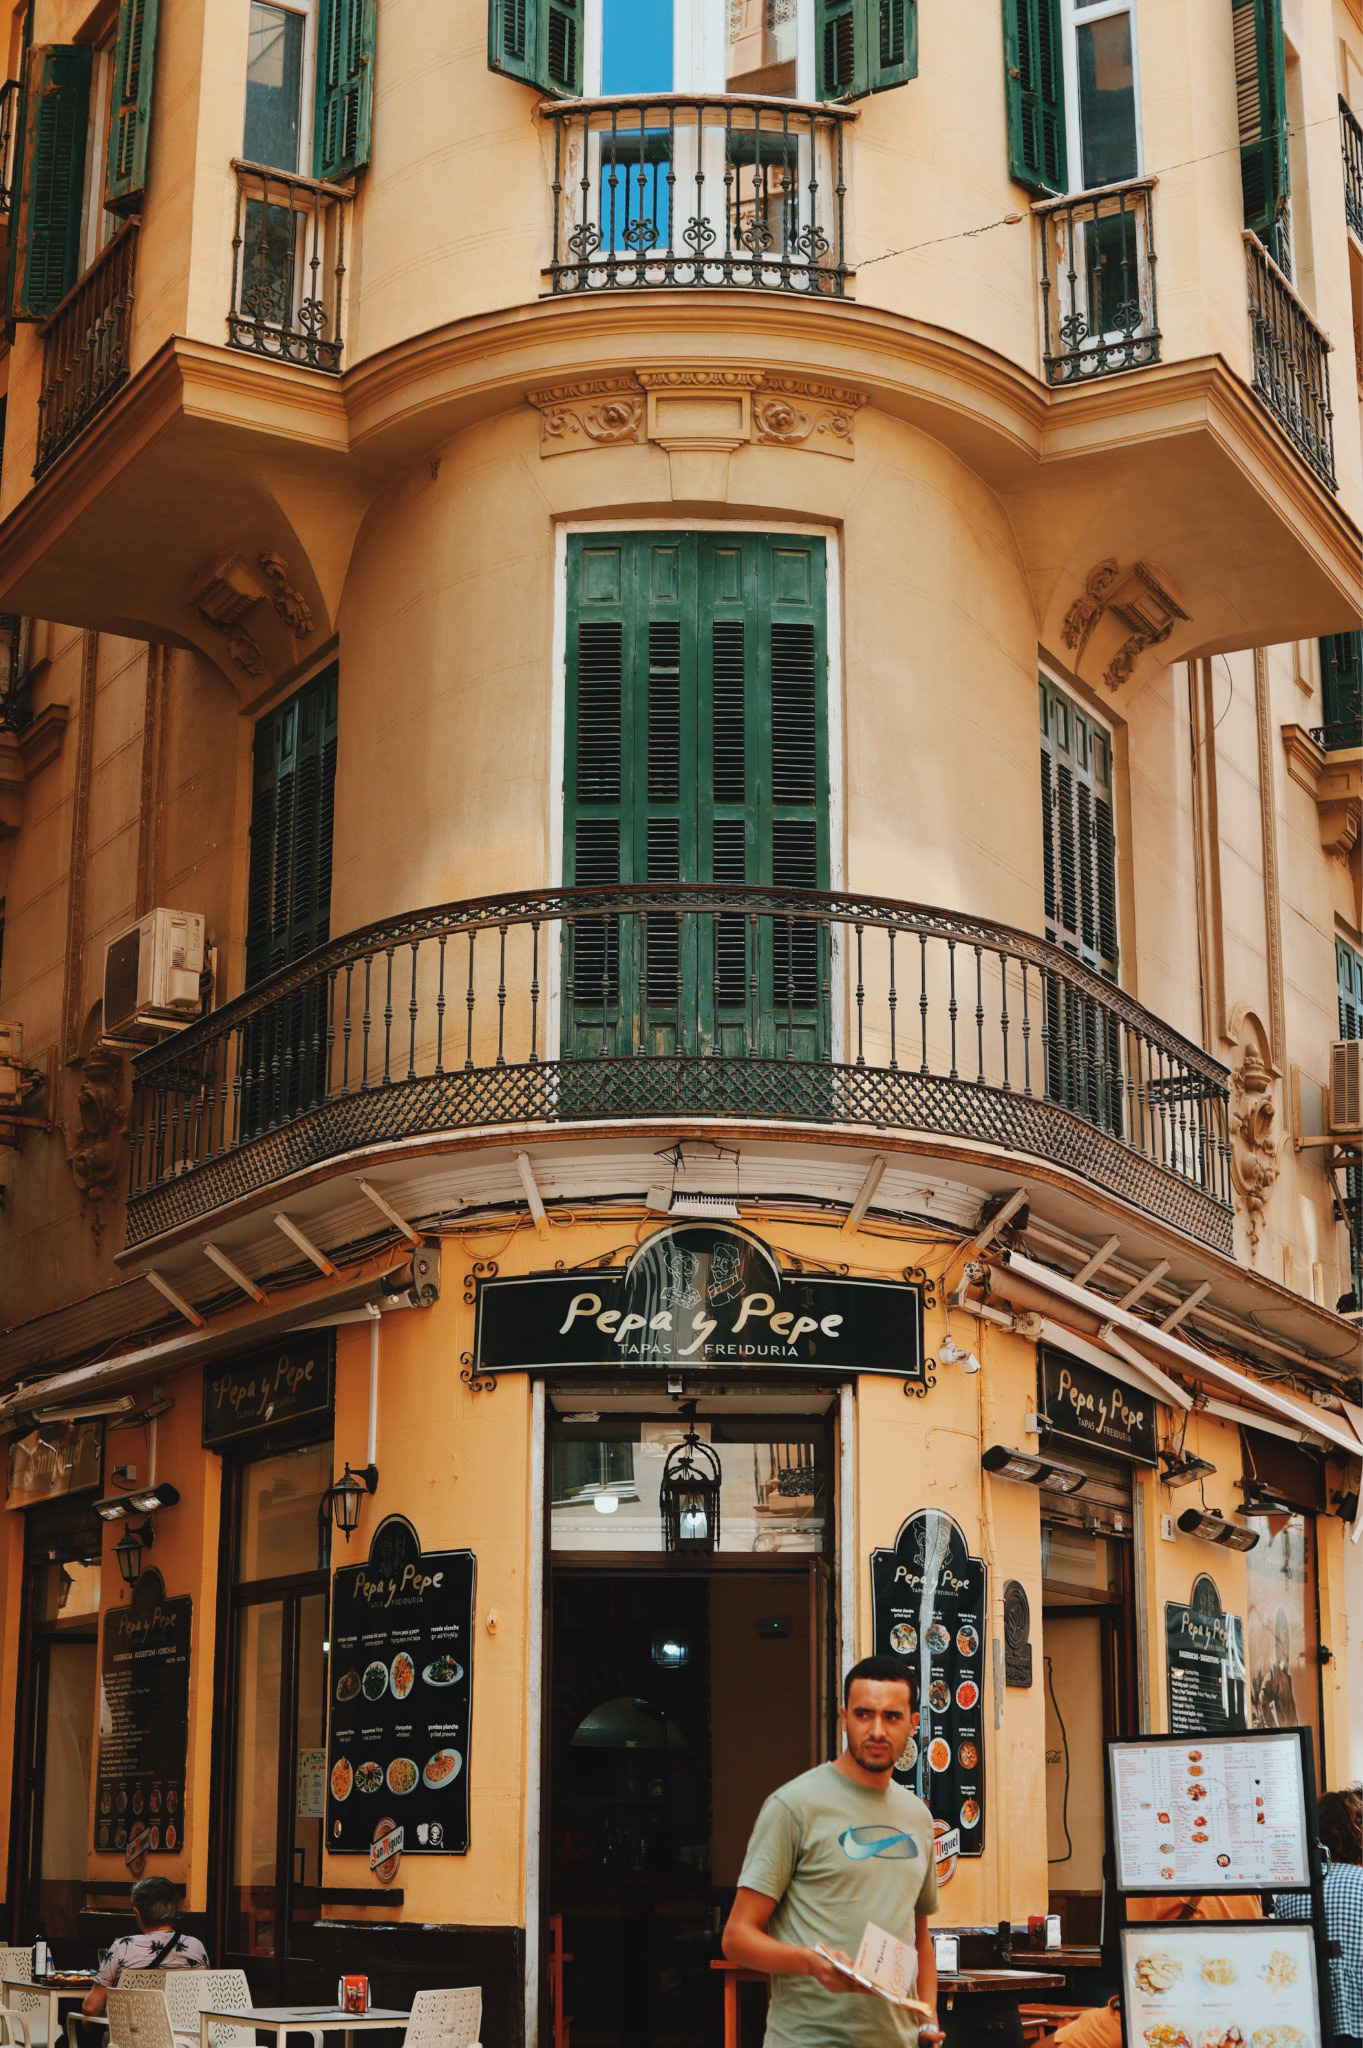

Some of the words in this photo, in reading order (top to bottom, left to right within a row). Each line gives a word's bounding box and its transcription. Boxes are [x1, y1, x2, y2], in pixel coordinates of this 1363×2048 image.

[558, 1292, 673, 1344] Pepa
[677, 1311, 718, 1356] y
[732, 1291, 843, 1344] Pepe
[618, 1343, 672, 1355] TAPAS
[704, 1343, 798, 1357] FREIDURIA
[217, 1373, 256, 1412] Pepa
[256, 1377, 270, 1415] y
[274, 1354, 315, 1393] Pepe
[1058, 1368, 1094, 1416] Pepa
[1095, 1397, 1107, 1434] y
[1110, 1388, 1144, 1433] Pepe
[1077, 1417, 1095, 1431] TAPAS
[1103, 1427, 1132, 1443] FREIDURIA
[353, 1571, 384, 1602] Pepa
[384, 1578, 397, 1608] y
[400, 1563, 444, 1596] Pepe
[894, 1565, 927, 1588] Pepa
[927, 1577, 939, 1595] y
[941, 1570, 970, 1592] Pepe
[391, 1596, 424, 1607] FREIDURIA
[118, 1613, 141, 1639] Pepa
[141, 1618, 150, 1643] y
[152, 1606, 177, 1632] Pepe
[1181, 1611, 1203, 1641] Pepa
[1203, 1626, 1211, 1651] y
[1212, 1618, 1229, 1646] Pep
[382, 1830, 403, 1856] Miguel
[934, 1832, 959, 1857] Miguel
